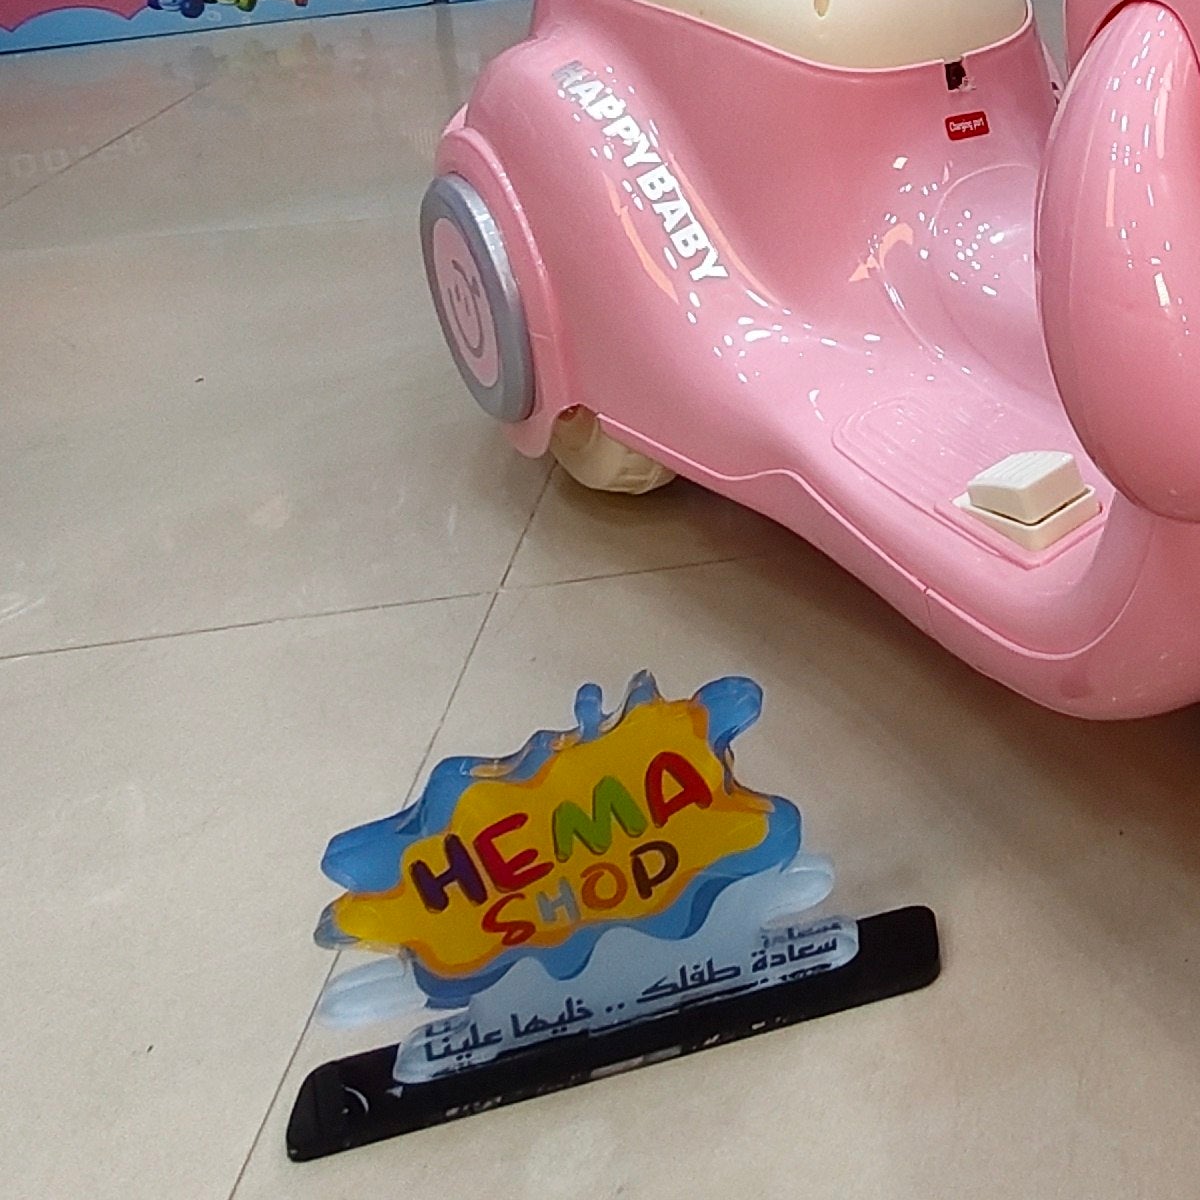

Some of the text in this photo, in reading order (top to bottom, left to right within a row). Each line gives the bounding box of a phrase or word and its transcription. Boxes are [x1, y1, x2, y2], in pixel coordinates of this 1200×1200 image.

[551, 60, 729, 281] HAPPY BABY
[410, 751, 713, 912] HEMA
[481, 839, 678, 945] SHOP
[752, 938, 838, 973] سعادة
[637, 958, 741, 1002] طفلك
[511, 997, 595, 1040] خليها
[425, 1023, 504, 1062] علينا
